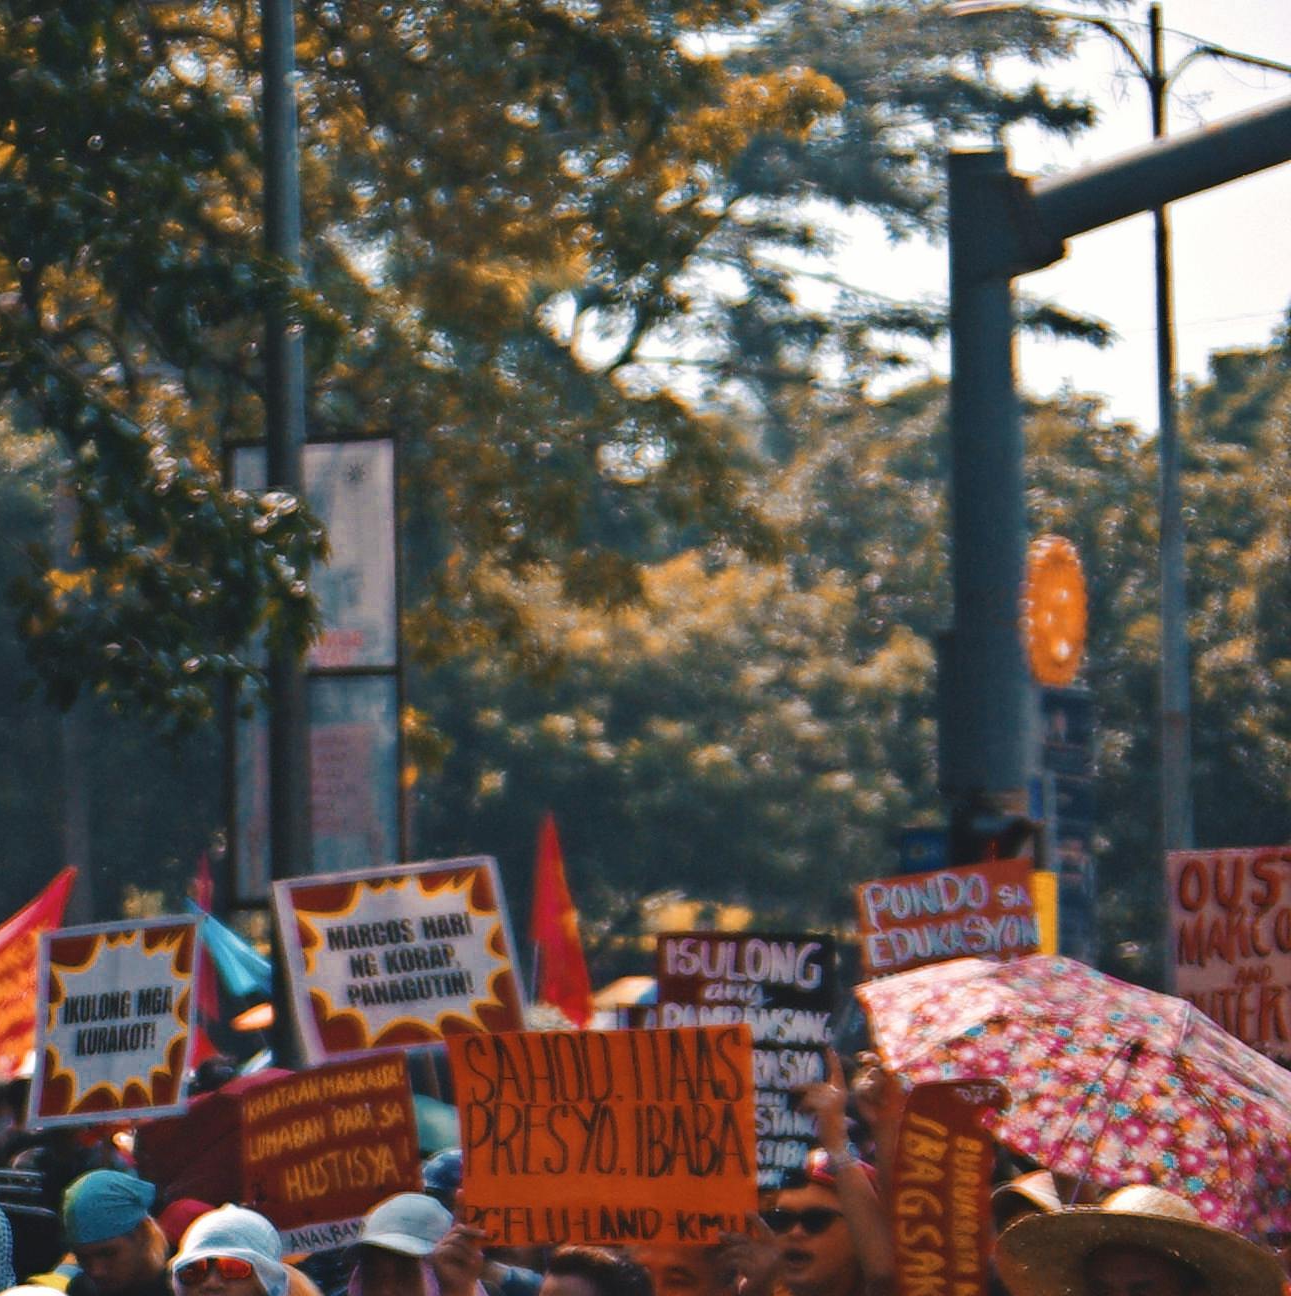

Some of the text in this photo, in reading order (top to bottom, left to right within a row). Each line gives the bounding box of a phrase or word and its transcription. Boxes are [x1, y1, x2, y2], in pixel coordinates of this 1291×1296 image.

[1179, 855, 1291, 913] OUS
[865, 873, 989, 937] PONDO
[327, 911, 474, 951] MARCOS HARI
[867, 913, 1041, 969] EDUKASYON
[349, 953, 379, 978] NG
[665, 938, 823, 990] ISULONG
[63, 985, 173, 1024] IKULONG MGA
[346, 969, 475, 1008] PANAGUTIN!
[76, 1021, 157, 1056] KURAKOT!
[380, 1101, 405, 1128] SA
[634, 1103, 750, 1177] IBABA
